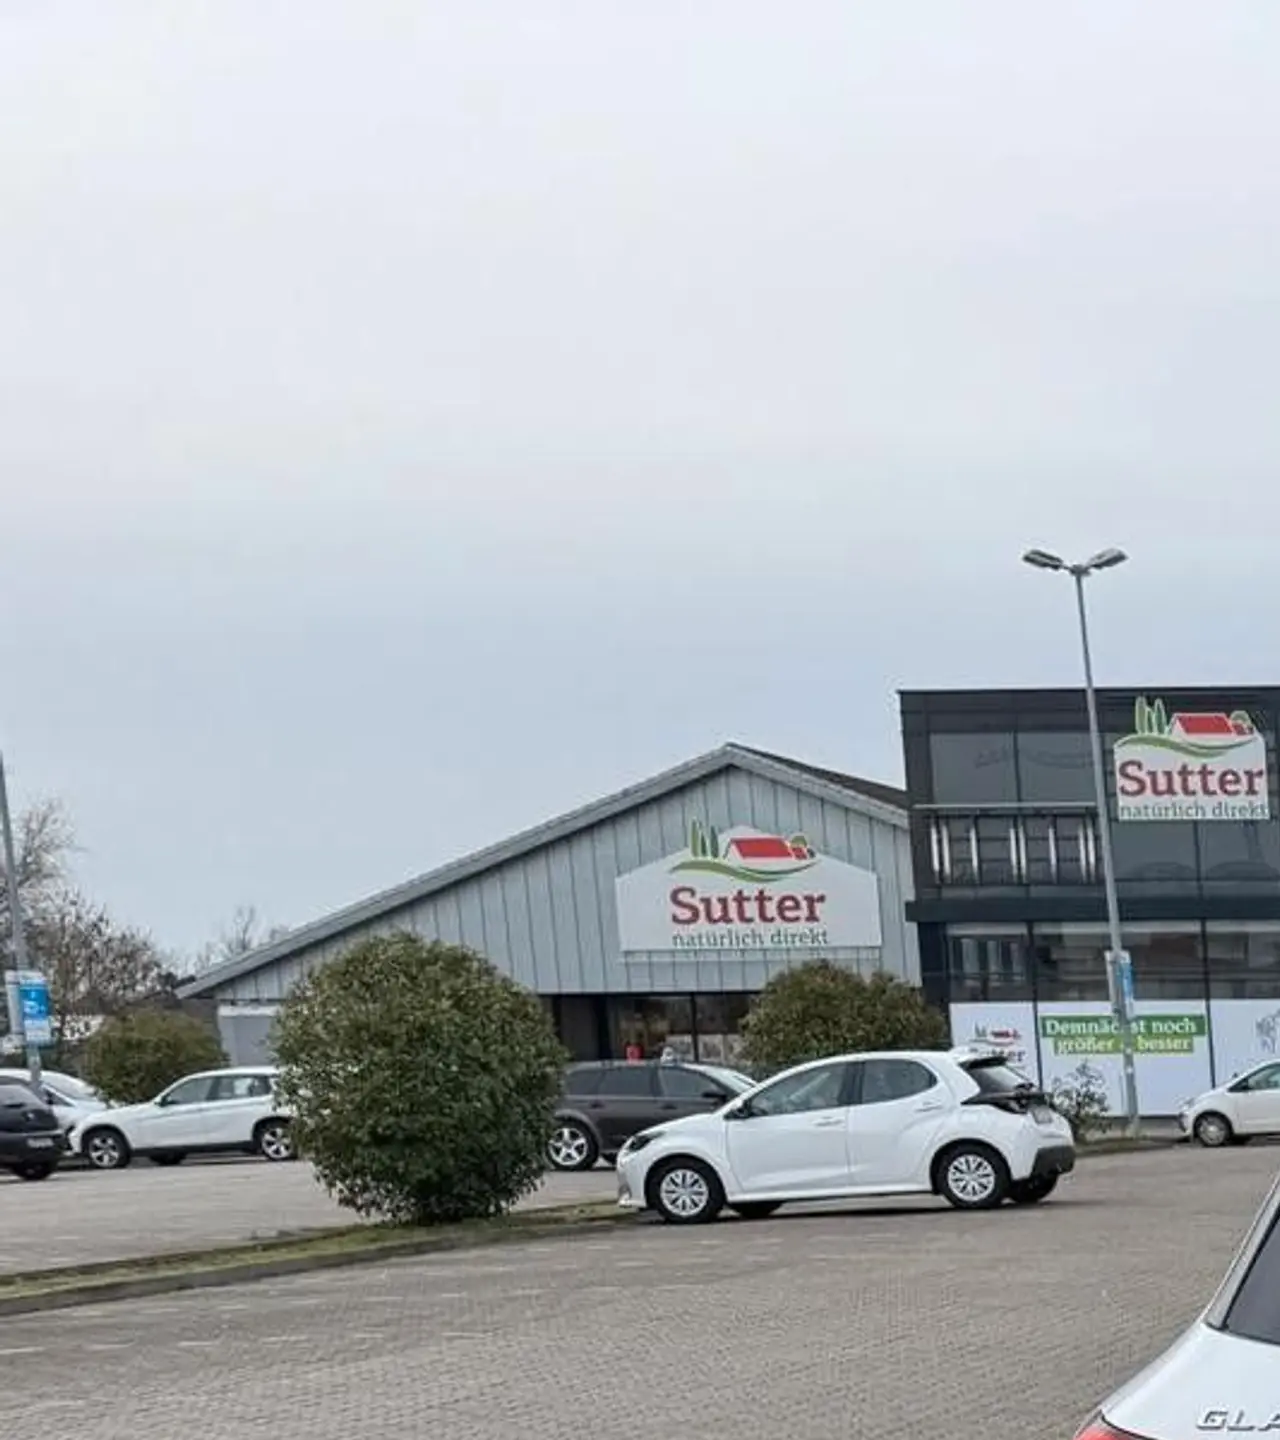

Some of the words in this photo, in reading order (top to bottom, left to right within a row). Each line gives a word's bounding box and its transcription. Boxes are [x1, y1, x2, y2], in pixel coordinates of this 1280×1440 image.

[1118, 759, 1264, 797] Sutter
[1120, 802, 1206, 818] natürlich
[1212, 801, 1268, 818] direkt
[669, 886, 826, 925] Sutter
[672, 928, 764, 947] natürlich
[770, 928, 828, 945] direkt
[1045, 1017, 1145, 1036] Demnäcst
[1151, 1016, 1197, 1035] noch
